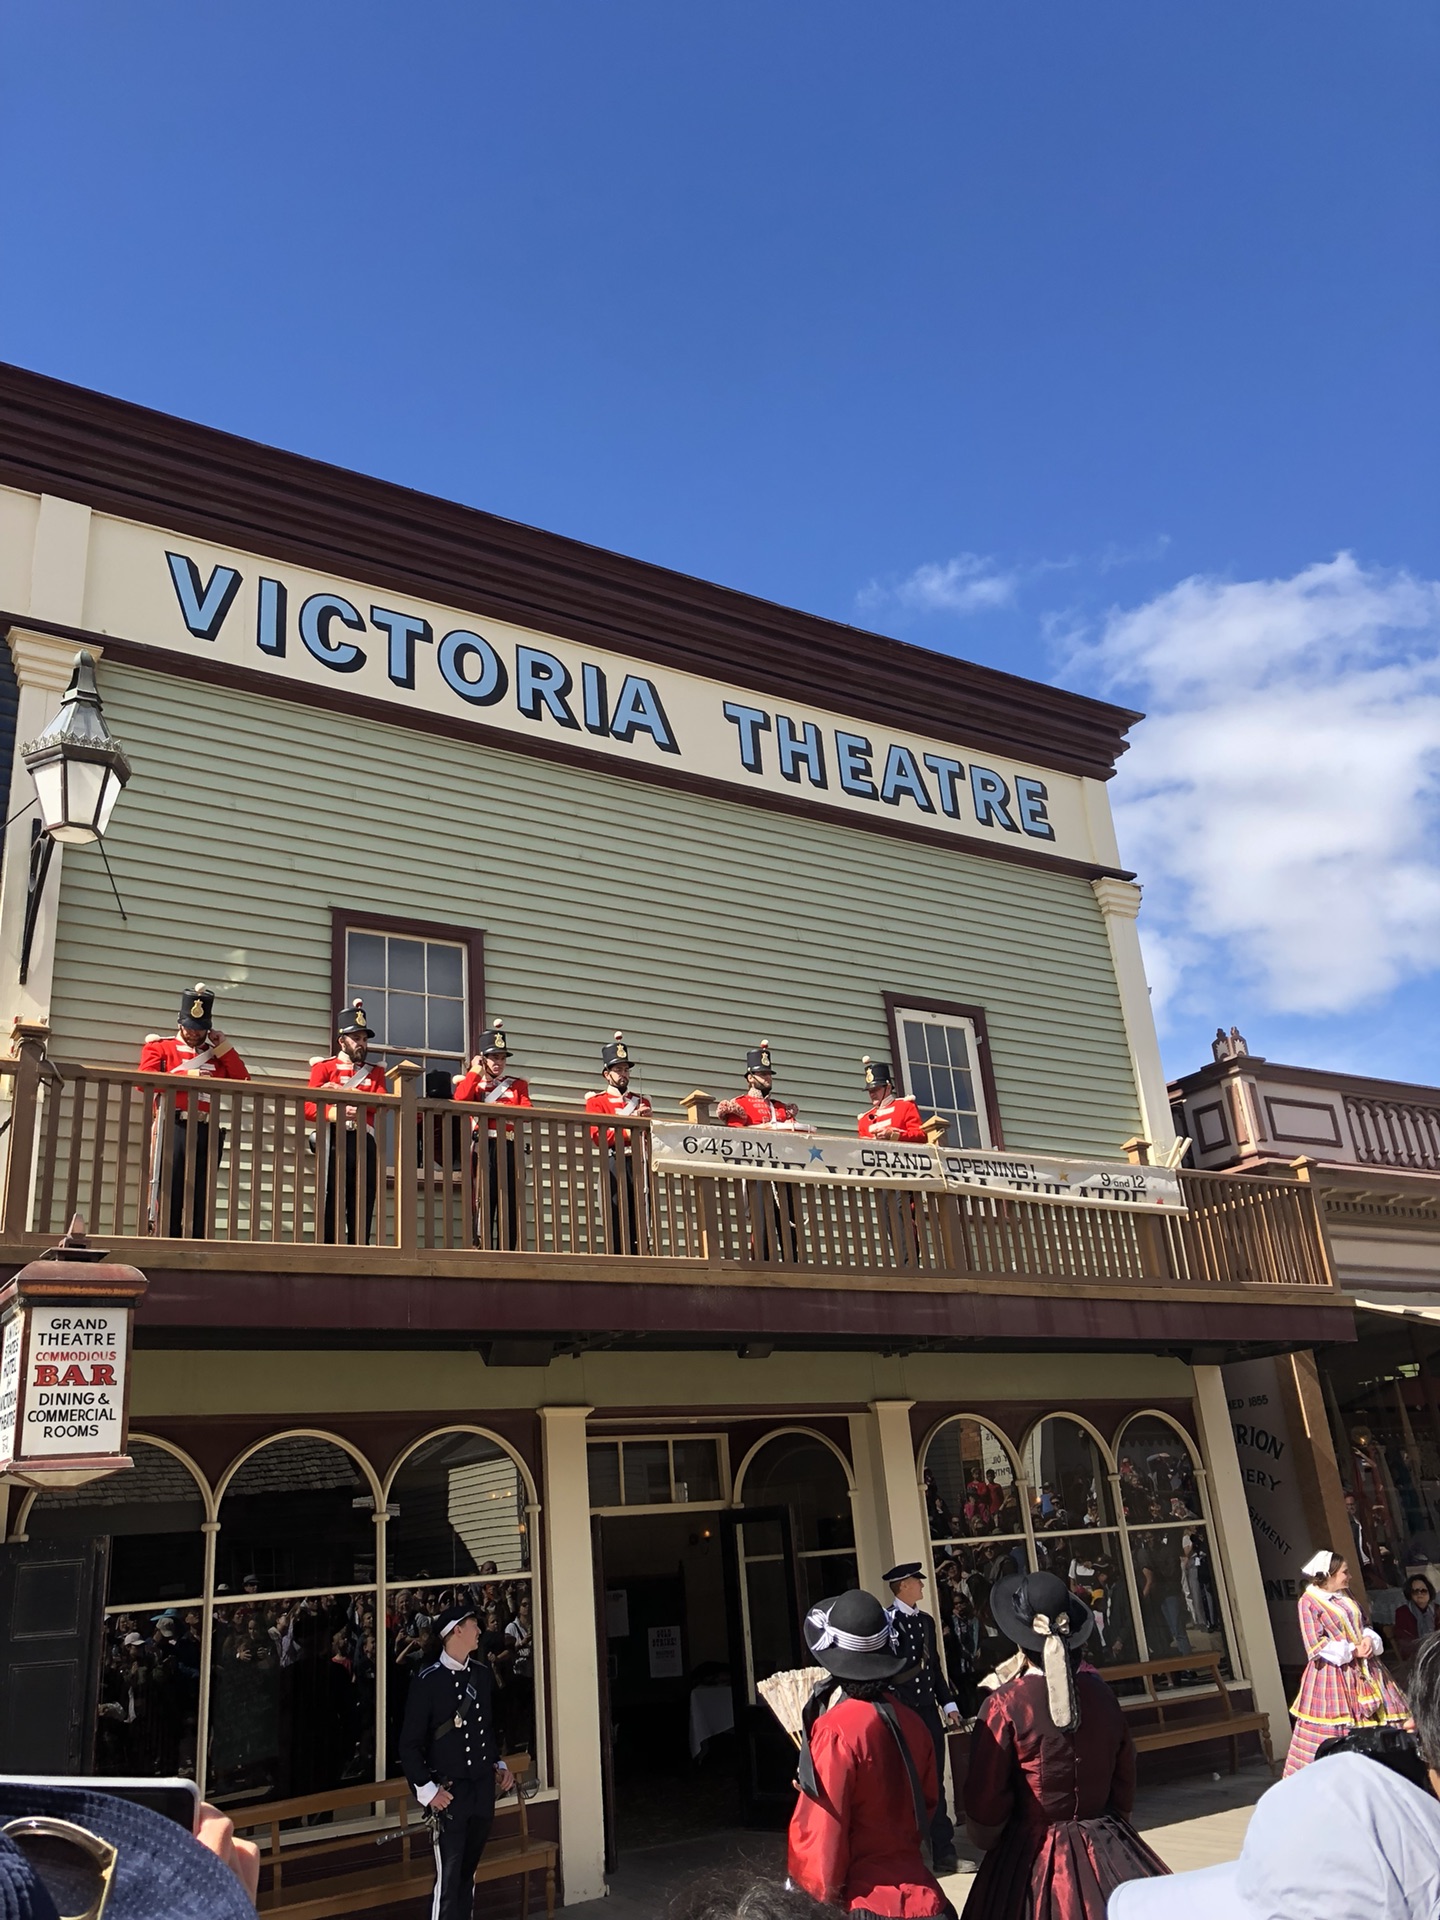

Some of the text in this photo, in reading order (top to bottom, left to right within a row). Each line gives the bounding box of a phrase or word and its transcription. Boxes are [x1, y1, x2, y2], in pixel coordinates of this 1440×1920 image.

[165, 550, 1056, 841] VICTORIA THEATRE
[683, 1136, 779, 1160] 6.45 P.M.
[861, 1149, 933, 1171] GRAND
[946, 1157, 1036, 1180] OPENING!
[1101, 1172, 1146, 1188] 9 and 12
[50, 1318, 108, 1330] GRAND
[38, 1332, 116, 1346] THEATRE
[35, 1351, 117, 1362] COMMODIOUS
[33, 1364, 117, 1387] BAR
[39, 1391, 110, 1406] DINING &
[1248, 1394, 1269, 1408] 1855
[27, 1408, 117, 1423] COMMERCIAL
[43, 1424, 99, 1438] ROOMS
[1235, 1423, 1285, 1460] RION
[1242, 1468, 1282, 1491] ERY
[1248, 1505, 1292, 1556] SHMENT
